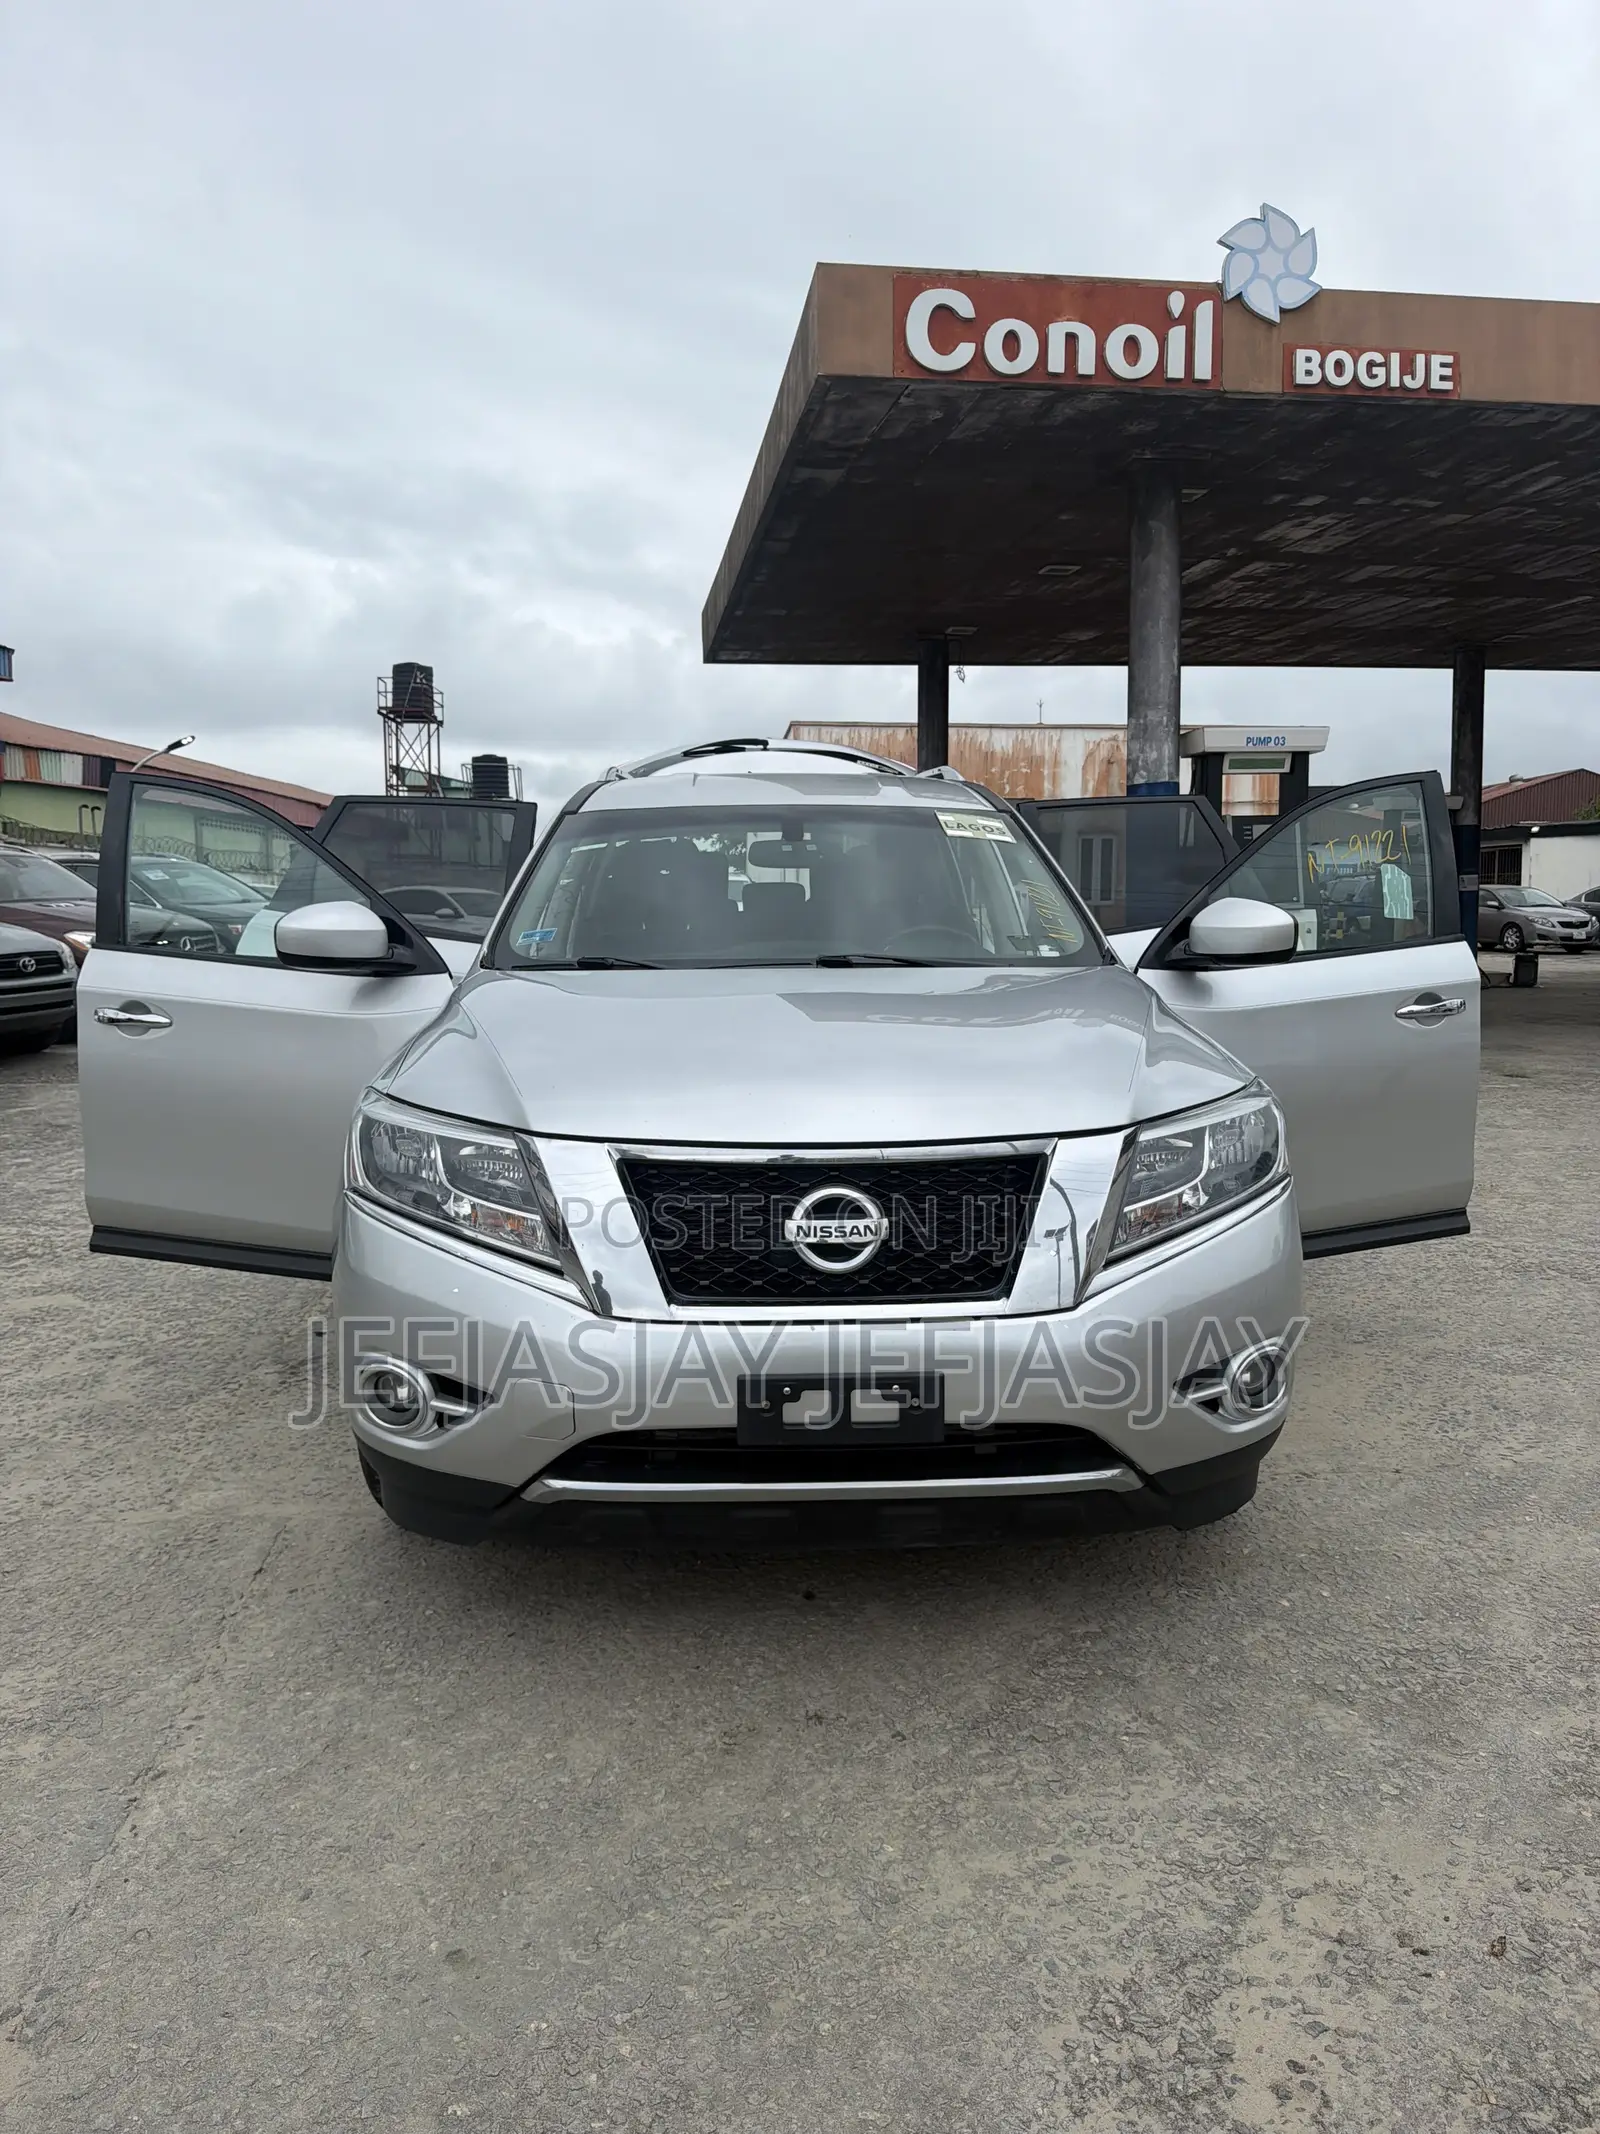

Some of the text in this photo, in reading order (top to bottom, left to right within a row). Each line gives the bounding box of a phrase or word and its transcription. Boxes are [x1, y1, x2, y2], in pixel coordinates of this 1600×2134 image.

[905, 288, 1214, 381] Conoil
[1293, 348, 1455, 392] BOGIJE
[1245, 736, 1286, 747] PUMP 03
[943, 820, 1007, 836] LAGOS
[796, 1224, 879, 1239] NISSAN
